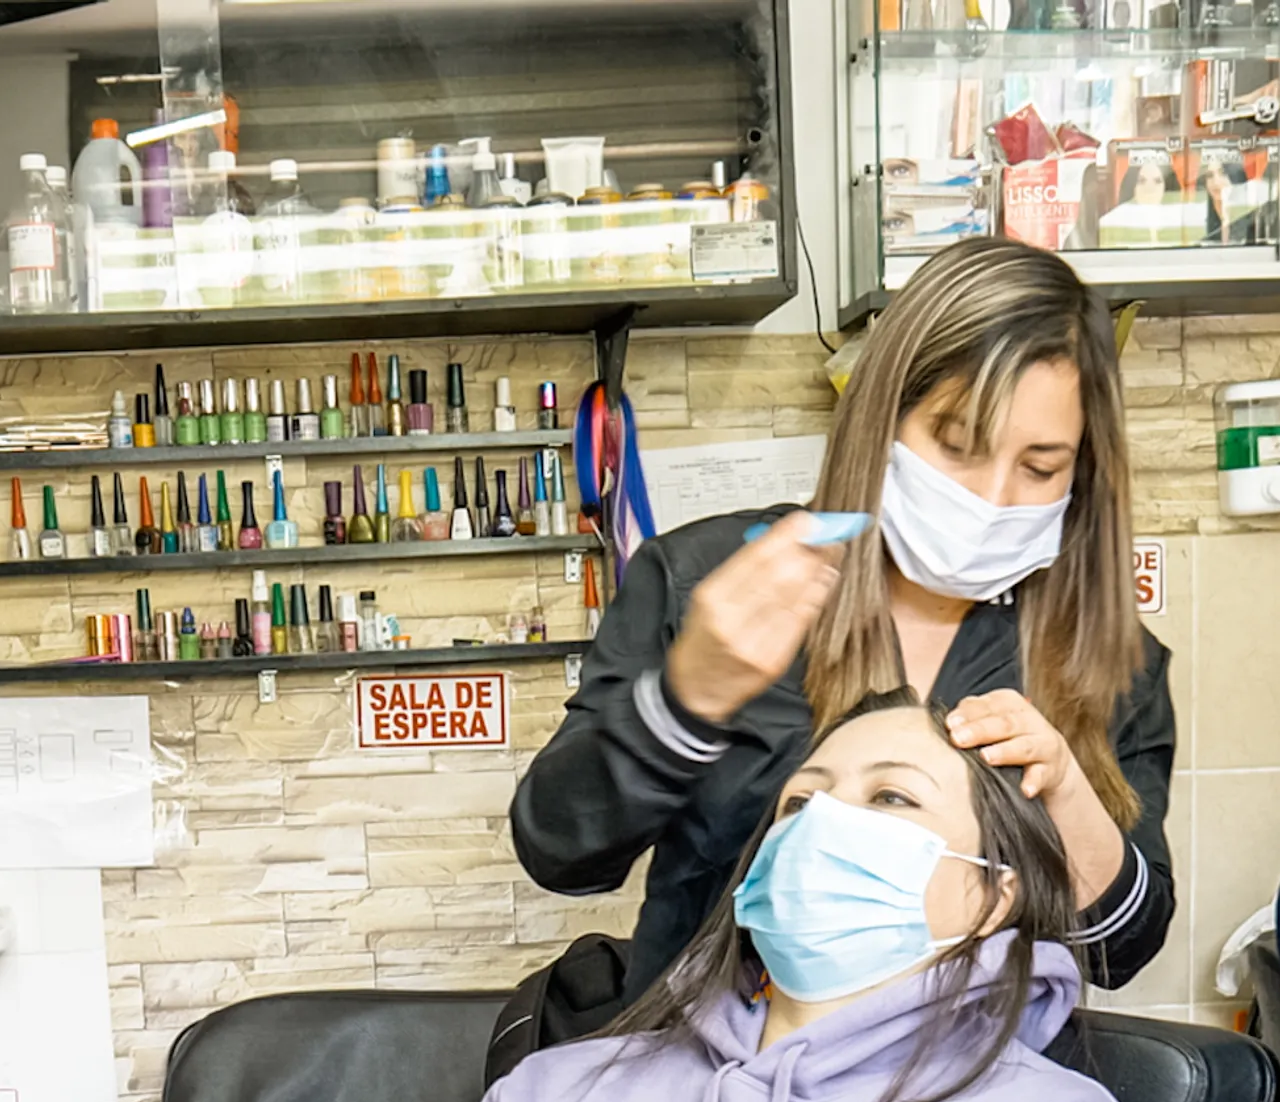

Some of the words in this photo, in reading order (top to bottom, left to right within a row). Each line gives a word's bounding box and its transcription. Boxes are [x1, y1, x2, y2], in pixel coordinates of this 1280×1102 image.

[370, 682, 445, 711] SALA
[456, 681, 492, 709] DE
[374, 711, 488, 740] ESPERA
